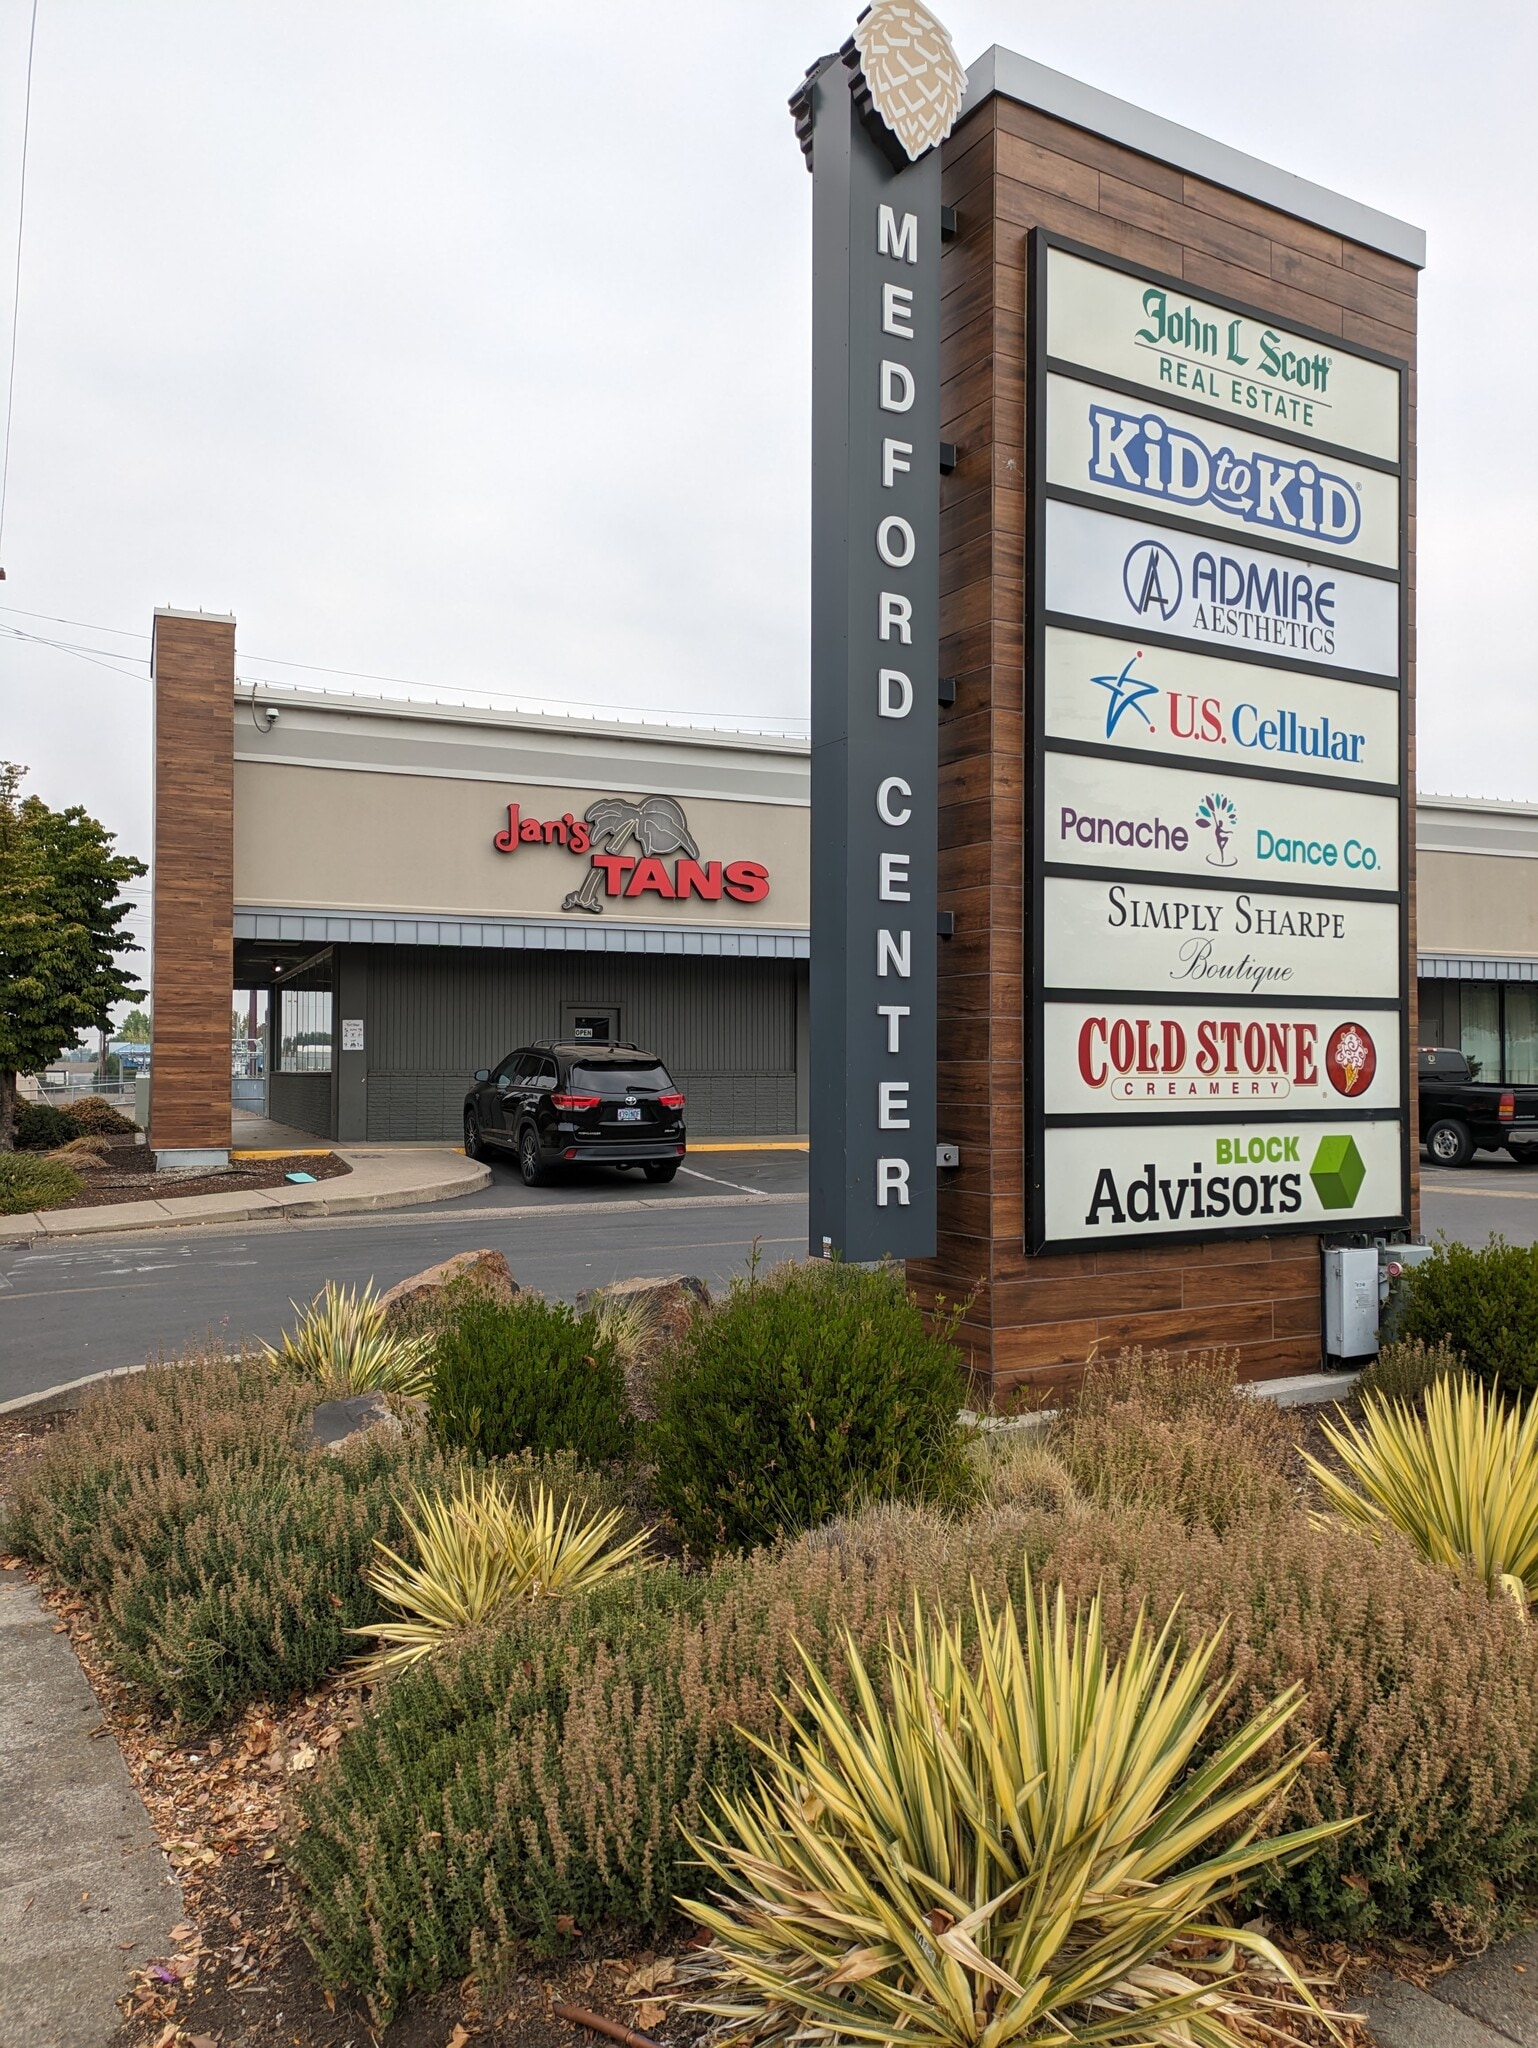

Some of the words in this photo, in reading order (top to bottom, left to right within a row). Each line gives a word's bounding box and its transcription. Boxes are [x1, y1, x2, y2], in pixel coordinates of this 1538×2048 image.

[1135, 288, 1218, 357] John
[1227, 319, 1249, 366] L
[1257, 330, 1330, 393] Scott
[1159, 357, 1220, 398] REAL
[1231, 381, 1314, 427] ESTATE
[876, 203, 919, 719] MEDFORD
[1215, 450, 1251, 495] to
[1192, 551, 1335, 628] ADMIRE
[1192, 603, 1335, 655] AESTHETICS
[1166, 691, 1227, 744] U.S.
[1232, 703, 1365, 763] Cellular
[494, 804, 592, 854] Jan's
[1061, 807, 1189, 851] Panache
[1257, 829, 1338, 867] Dance
[1344, 839, 1381, 871] Co.
[591, 854, 770, 902] TANS
[876, 776, 913, 1207] CENTER
[1169, 937, 1294, 992] Boutique
[1078, 1017, 1187, 1088] COLD
[1195, 1020, 1318, 1086] STONE
[1123, 1081, 1279, 1096] CREAMERY
[1216, 1136, 1300, 1165] BLOCK
[1085, 1162, 1302, 1225] Advisors
